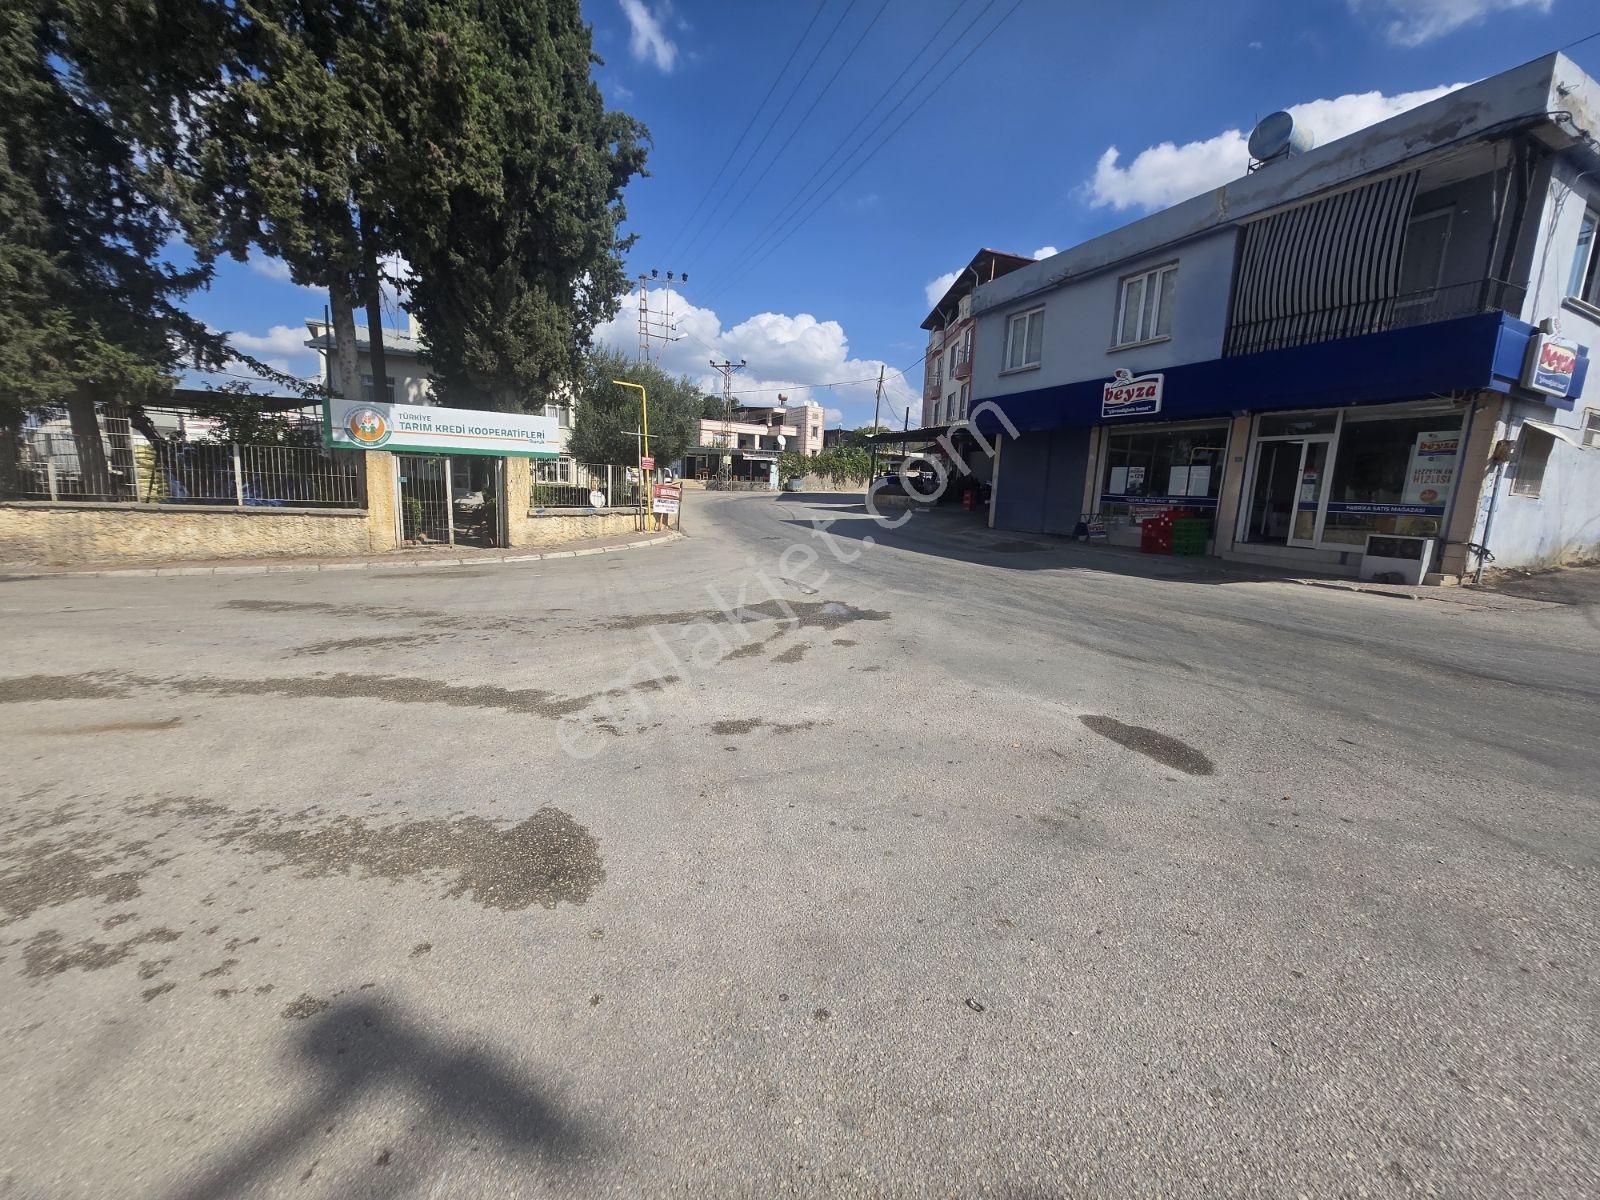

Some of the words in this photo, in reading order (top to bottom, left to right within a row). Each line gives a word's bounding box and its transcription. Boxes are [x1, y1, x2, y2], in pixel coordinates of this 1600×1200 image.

[1104, 384, 1157, 402] beyza
[398, 411, 432, 422] TÜRKİYE
[399, 421, 433, 432] TARIM
[435, 423, 466, 434] KREDİ
[468, 426, 545, 440] KOOPERATİFLERİ
